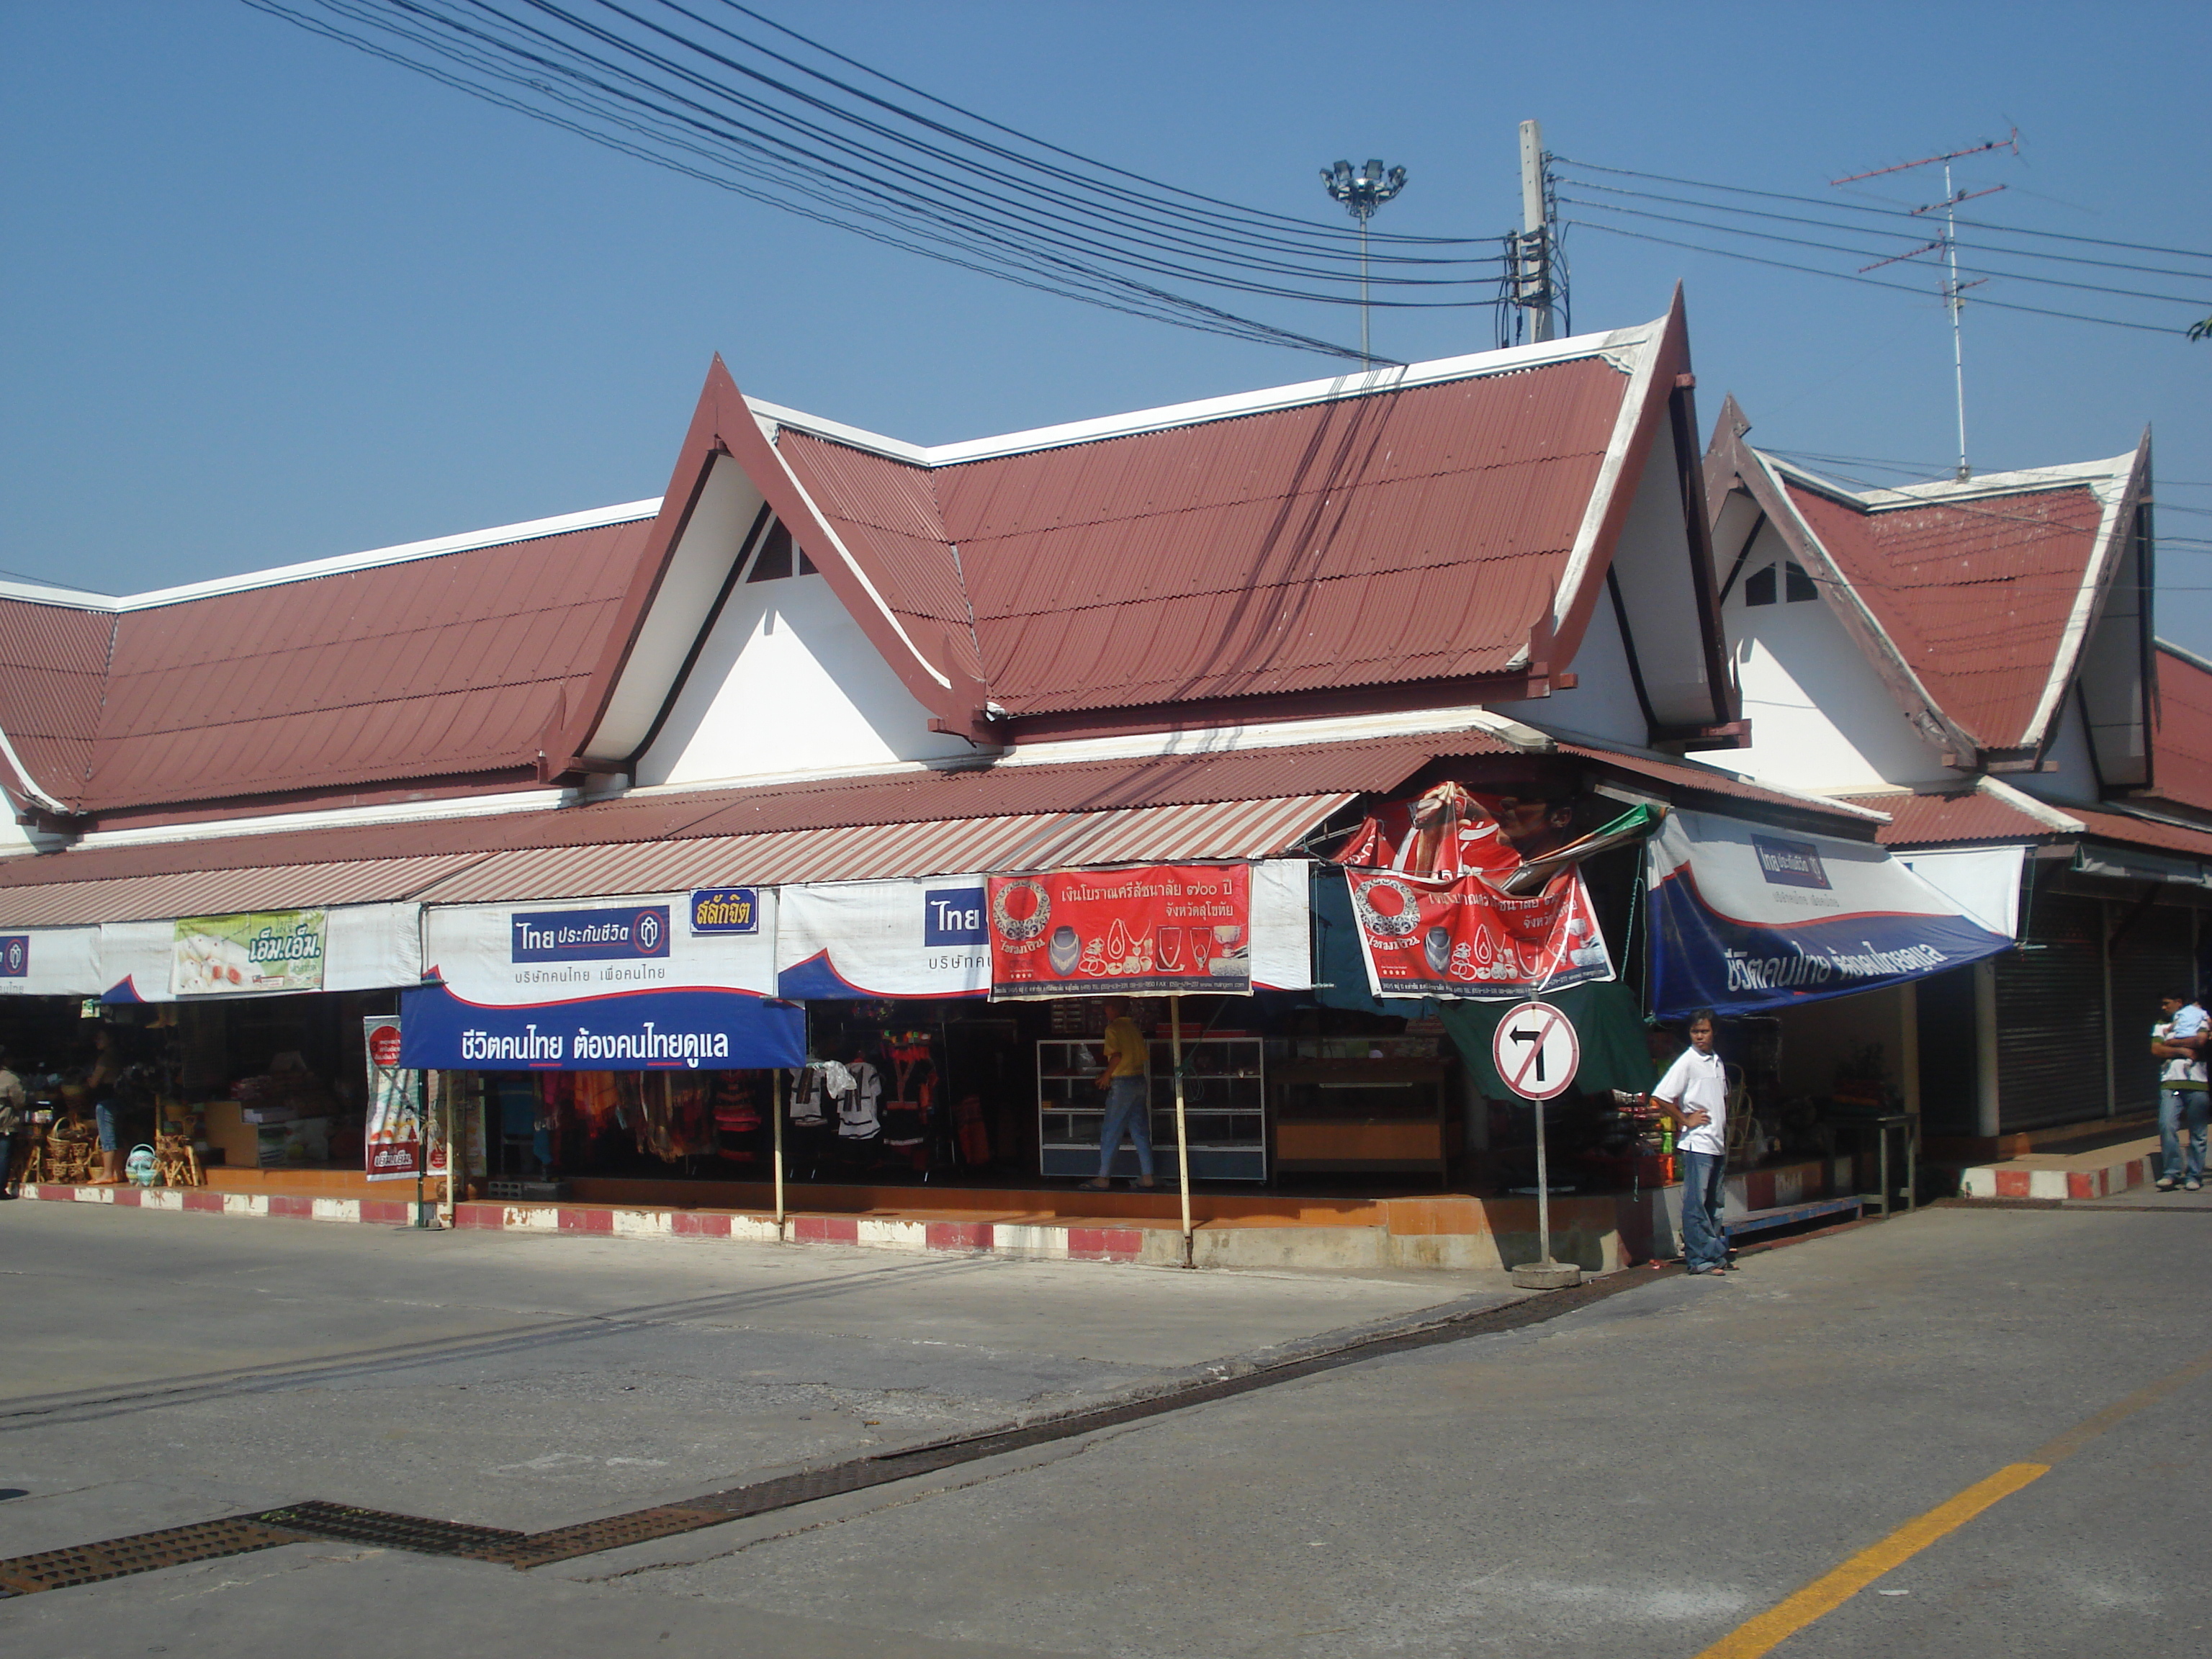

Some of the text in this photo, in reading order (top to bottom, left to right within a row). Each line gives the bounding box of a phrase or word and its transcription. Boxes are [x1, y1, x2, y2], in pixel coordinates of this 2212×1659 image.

[1754, 843, 1781, 872] ไทย
[1061, 878, 1182, 902] เงินโบราณศรีสัชนาลัย
[1223, 878, 1233, 896] ปี
[696, 894, 751, 925] สลักจิต
[930, 899, 980, 932] ไทย
[1165, 901, 1233, 921] จังหวัดสุโขทัย
[248, 923, 322, 963] เอ็ม.เอ็ม.
[516, 922, 629, 950] ไทย ประกันชีวิต
[516, 964, 665, 984] บริษัทคนไทย เพื่อคนไทย
[1724, 940, 1832, 992] ชีวิตคนไทย
[462, 1022, 729, 1069] ชีวิตคนไทย ต้องคนไทยดูแล
